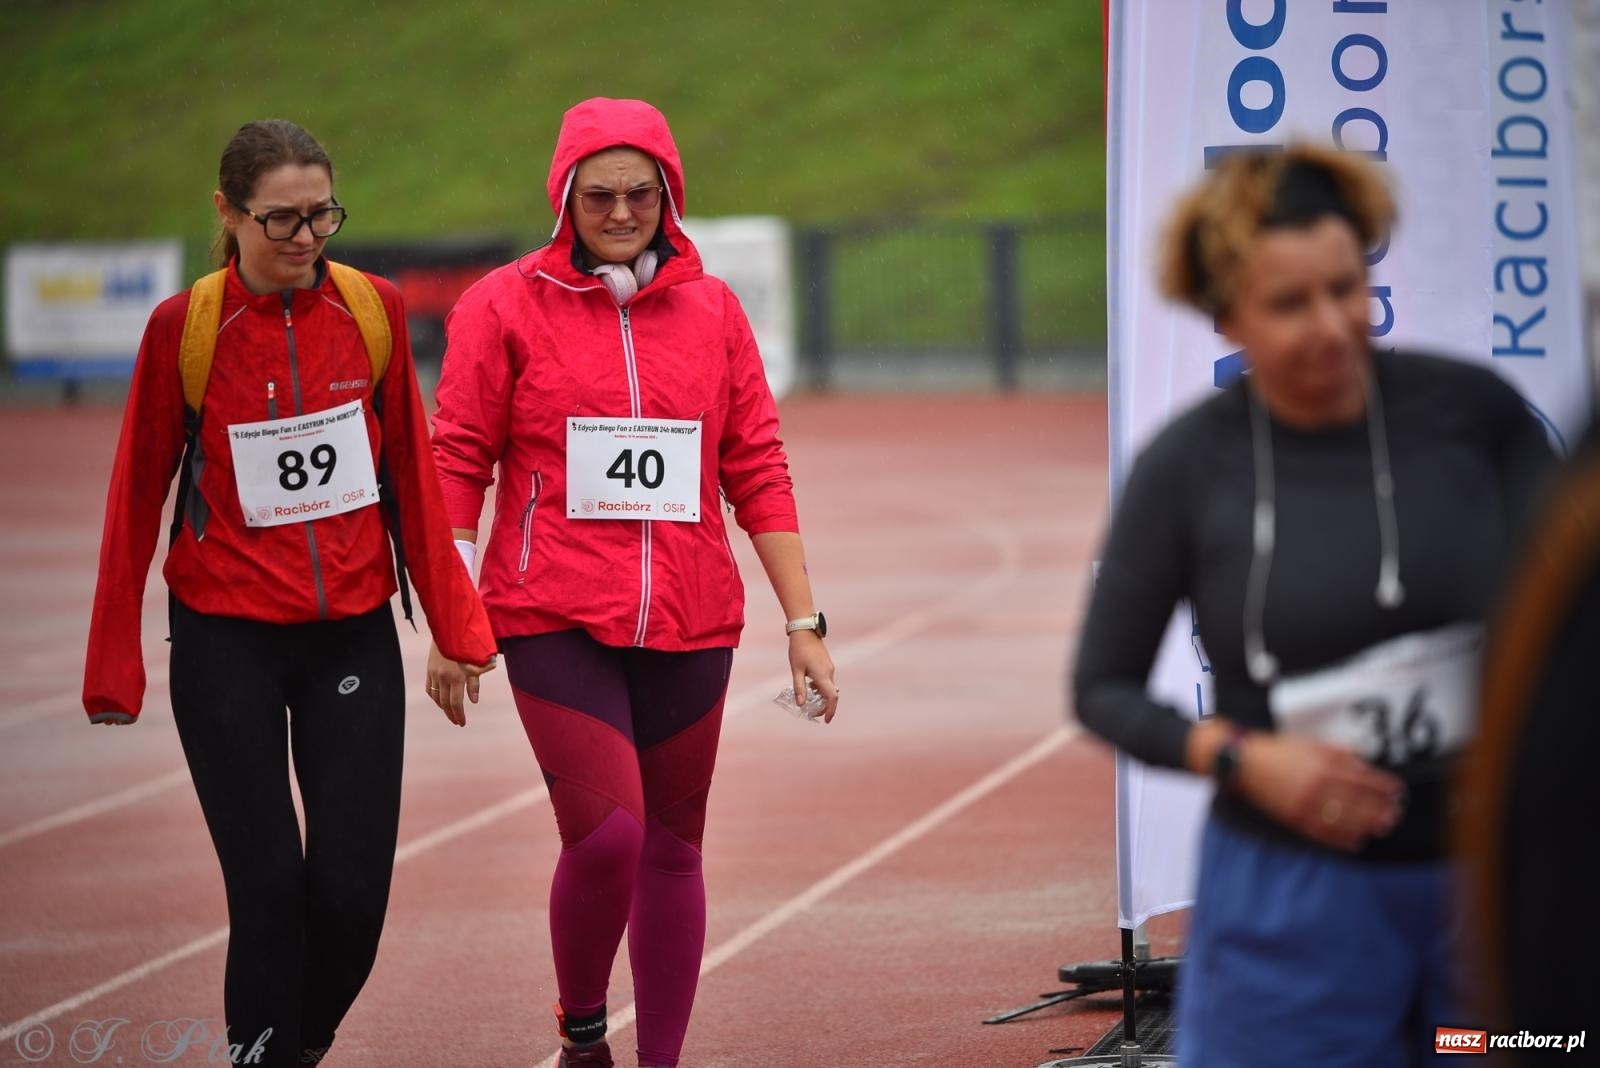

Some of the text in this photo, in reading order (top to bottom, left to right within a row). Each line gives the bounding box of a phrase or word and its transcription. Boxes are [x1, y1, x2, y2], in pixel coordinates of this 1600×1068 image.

[1491, 0, 1549, 358] Racibor
[277, 443, 337, 491] 89
[606, 448, 665, 490] 40
[274, 500, 331, 517] Racibórz
[598, 501, 652, 512] Racibórz
